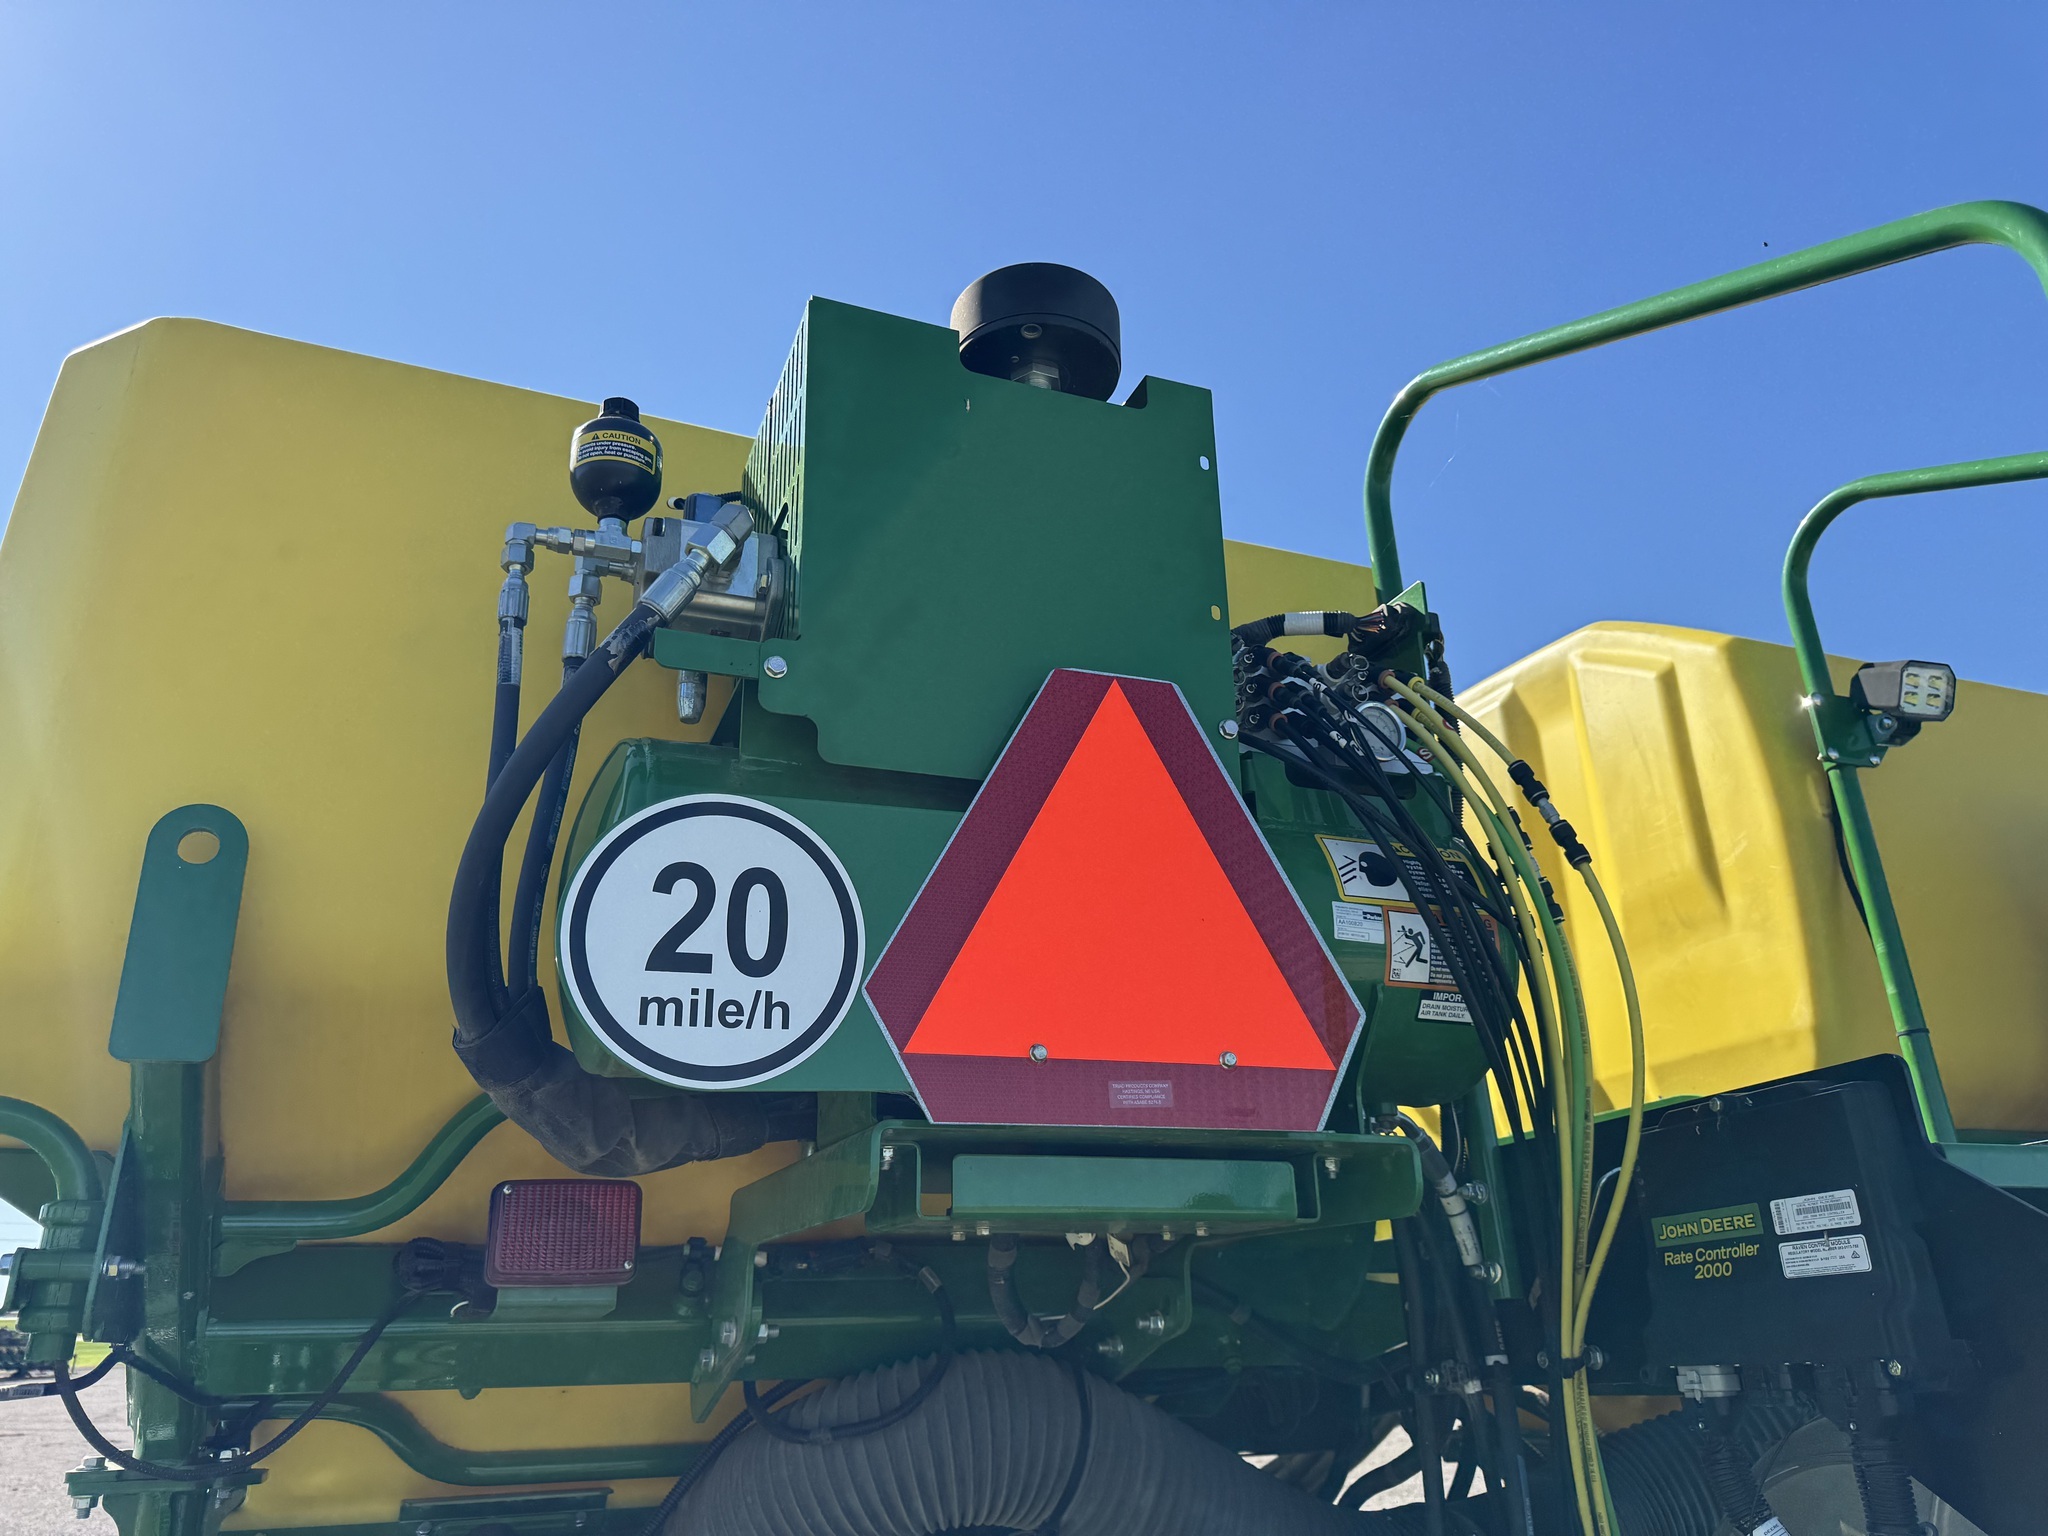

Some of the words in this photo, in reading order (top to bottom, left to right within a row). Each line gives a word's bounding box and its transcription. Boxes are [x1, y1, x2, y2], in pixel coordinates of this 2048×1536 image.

[602, 432, 641, 445] CAUTION
[644, 861, 789, 978] 20
[1433, 992, 1465, 1002] IMPOR
[638, 988, 790, 1030] mile/h
[1659, 1222, 1699, 1240] JOHN
[1700, 1214, 1756, 1234] DEERE
[1664, 1251, 1694, 1266] Rate
[1695, 1243, 1760, 1262] Controller
[1694, 1262, 1732, 1279] 2000
